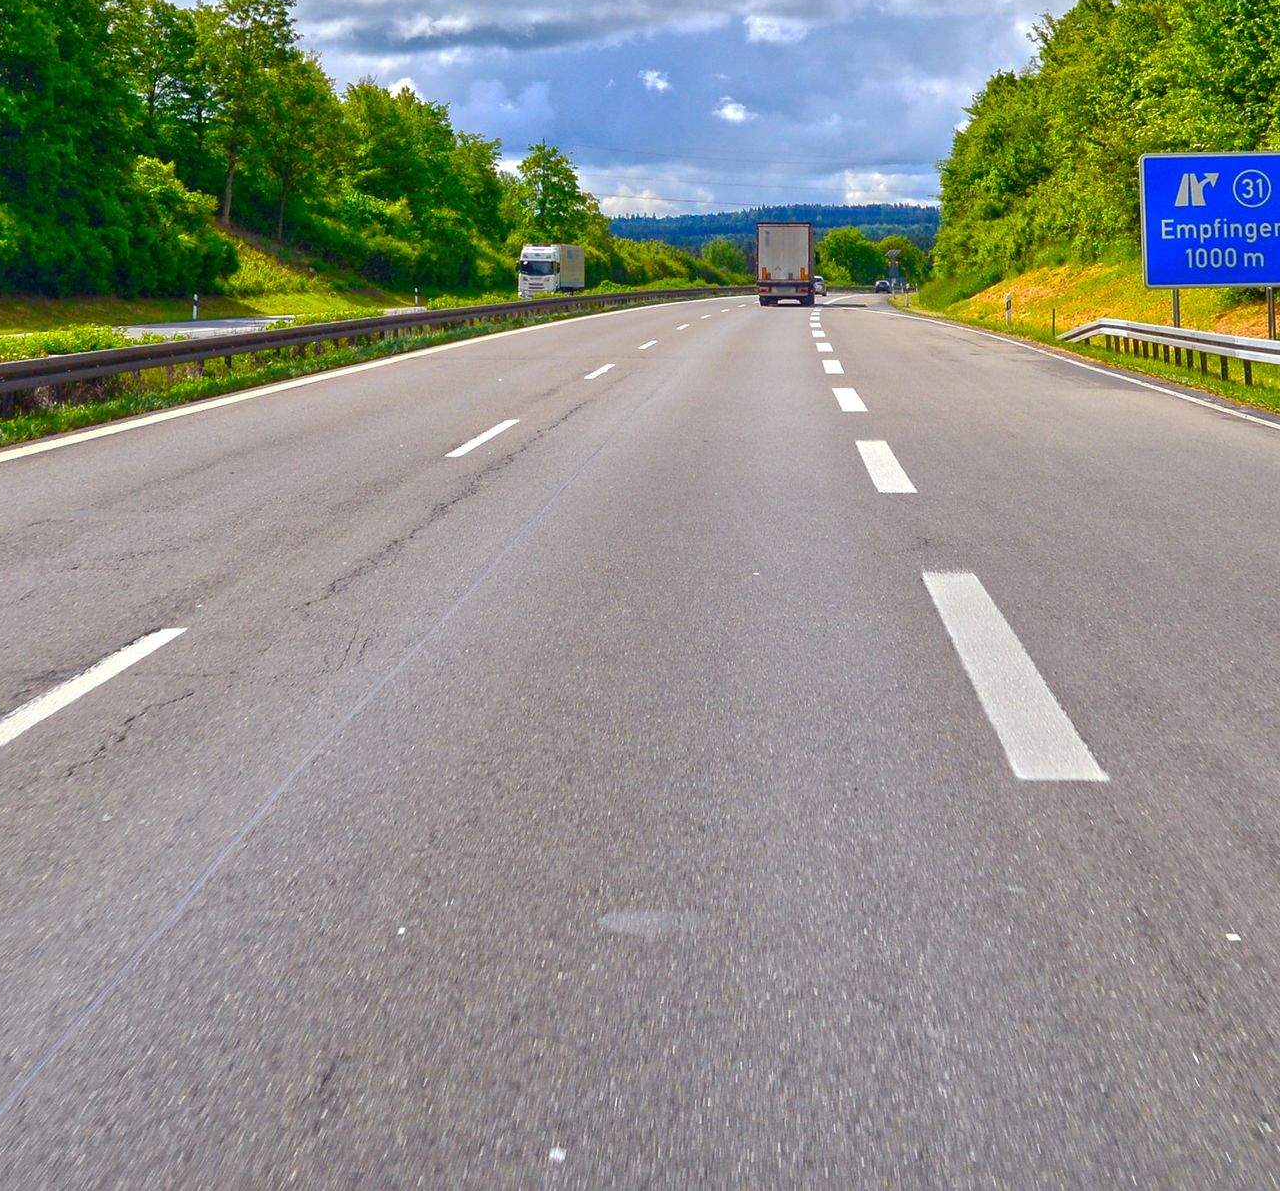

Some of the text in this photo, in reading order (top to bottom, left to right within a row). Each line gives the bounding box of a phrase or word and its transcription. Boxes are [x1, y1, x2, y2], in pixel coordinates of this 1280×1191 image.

[1241, 178, 1263, 198] 31
[1185, 248, 1264, 268] 1000 m
